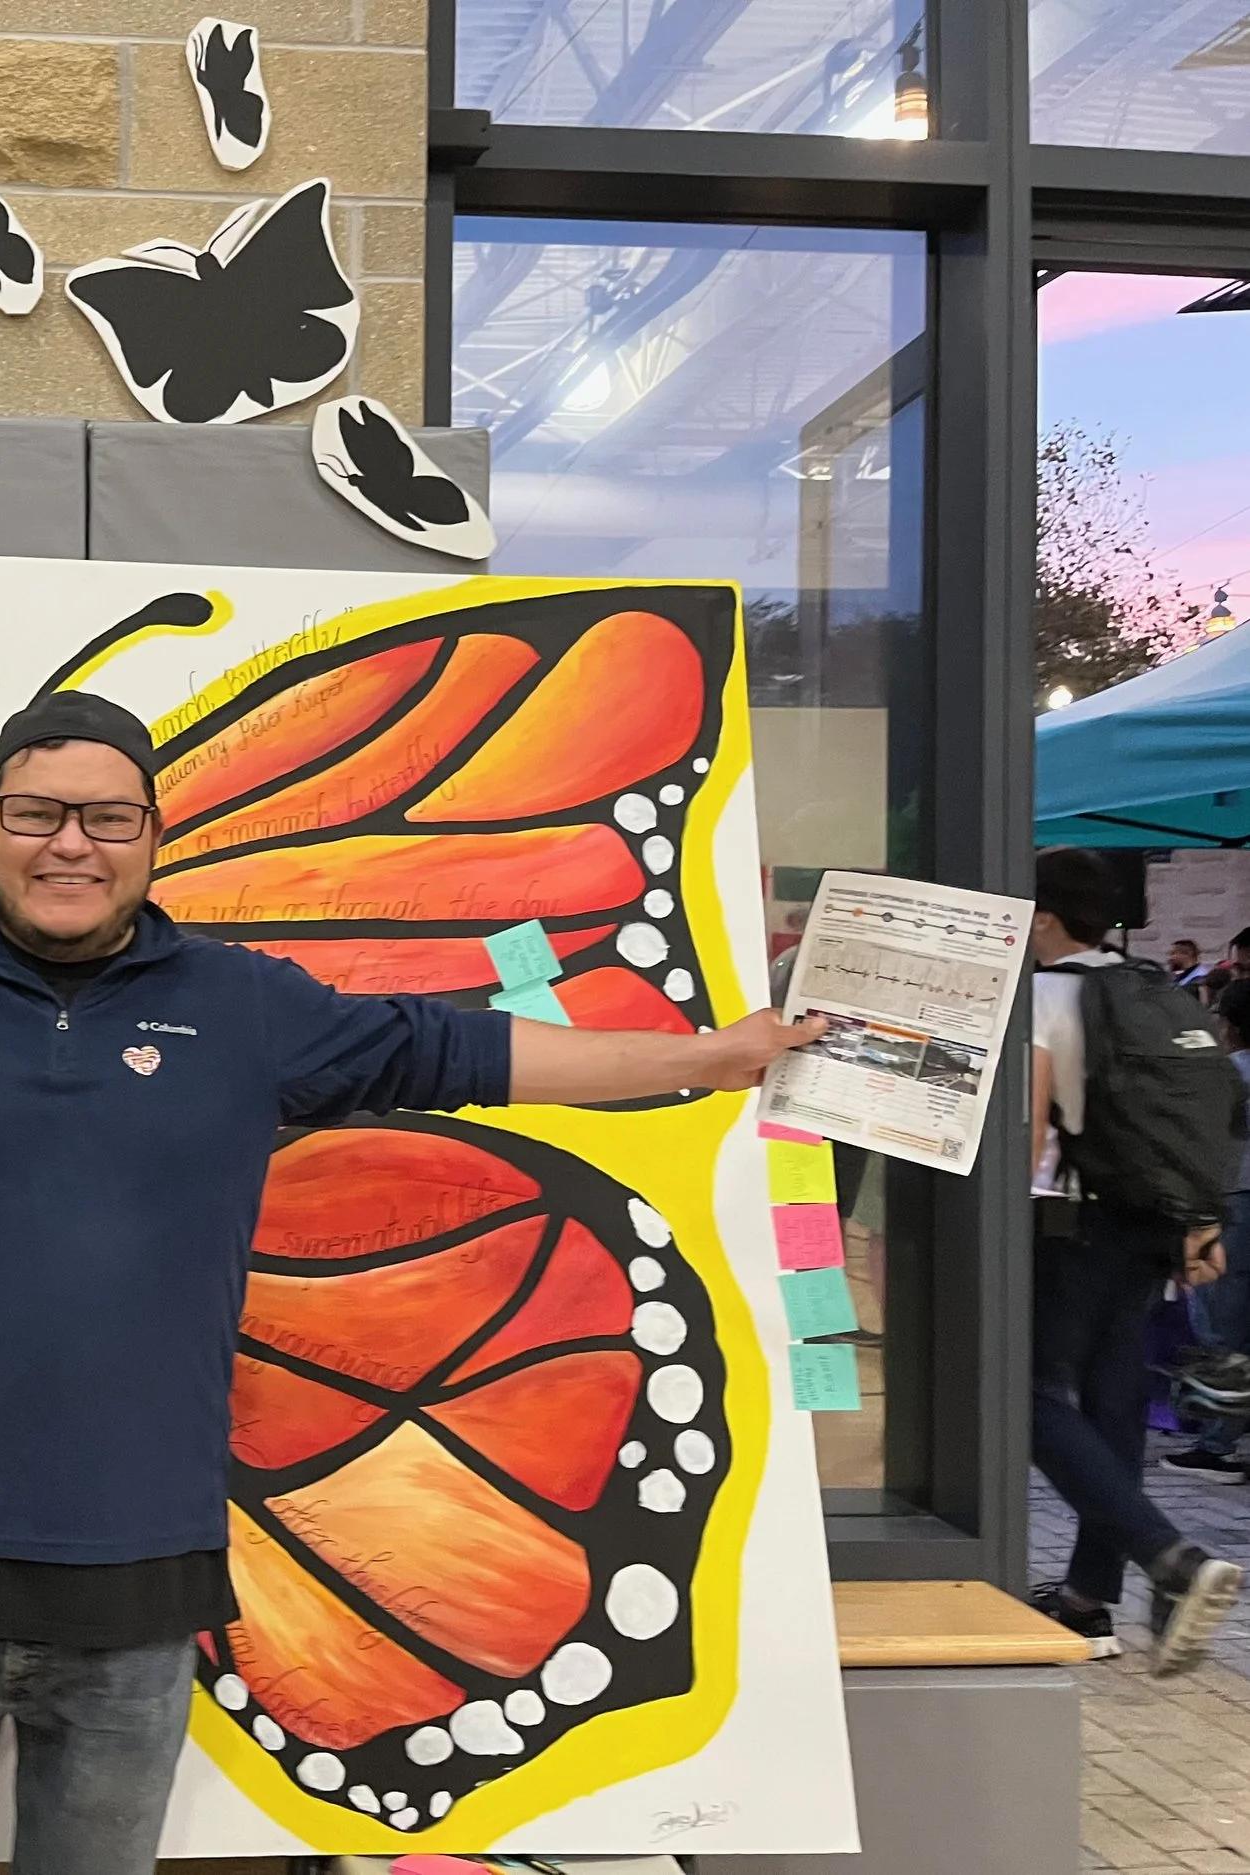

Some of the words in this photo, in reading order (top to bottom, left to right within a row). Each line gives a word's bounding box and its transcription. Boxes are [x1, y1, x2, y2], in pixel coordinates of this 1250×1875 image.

[150, 671, 216, 743] narch
[155, 755, 206, 800] slation
[238, 705, 287, 750] Peter
[197, 834, 212, 854] a
[222, 792, 332, 843] monarch
[343, 735, 456, 813] butterfly
[211, 884, 264, 922] who
[449, 882, 497, 919] the
